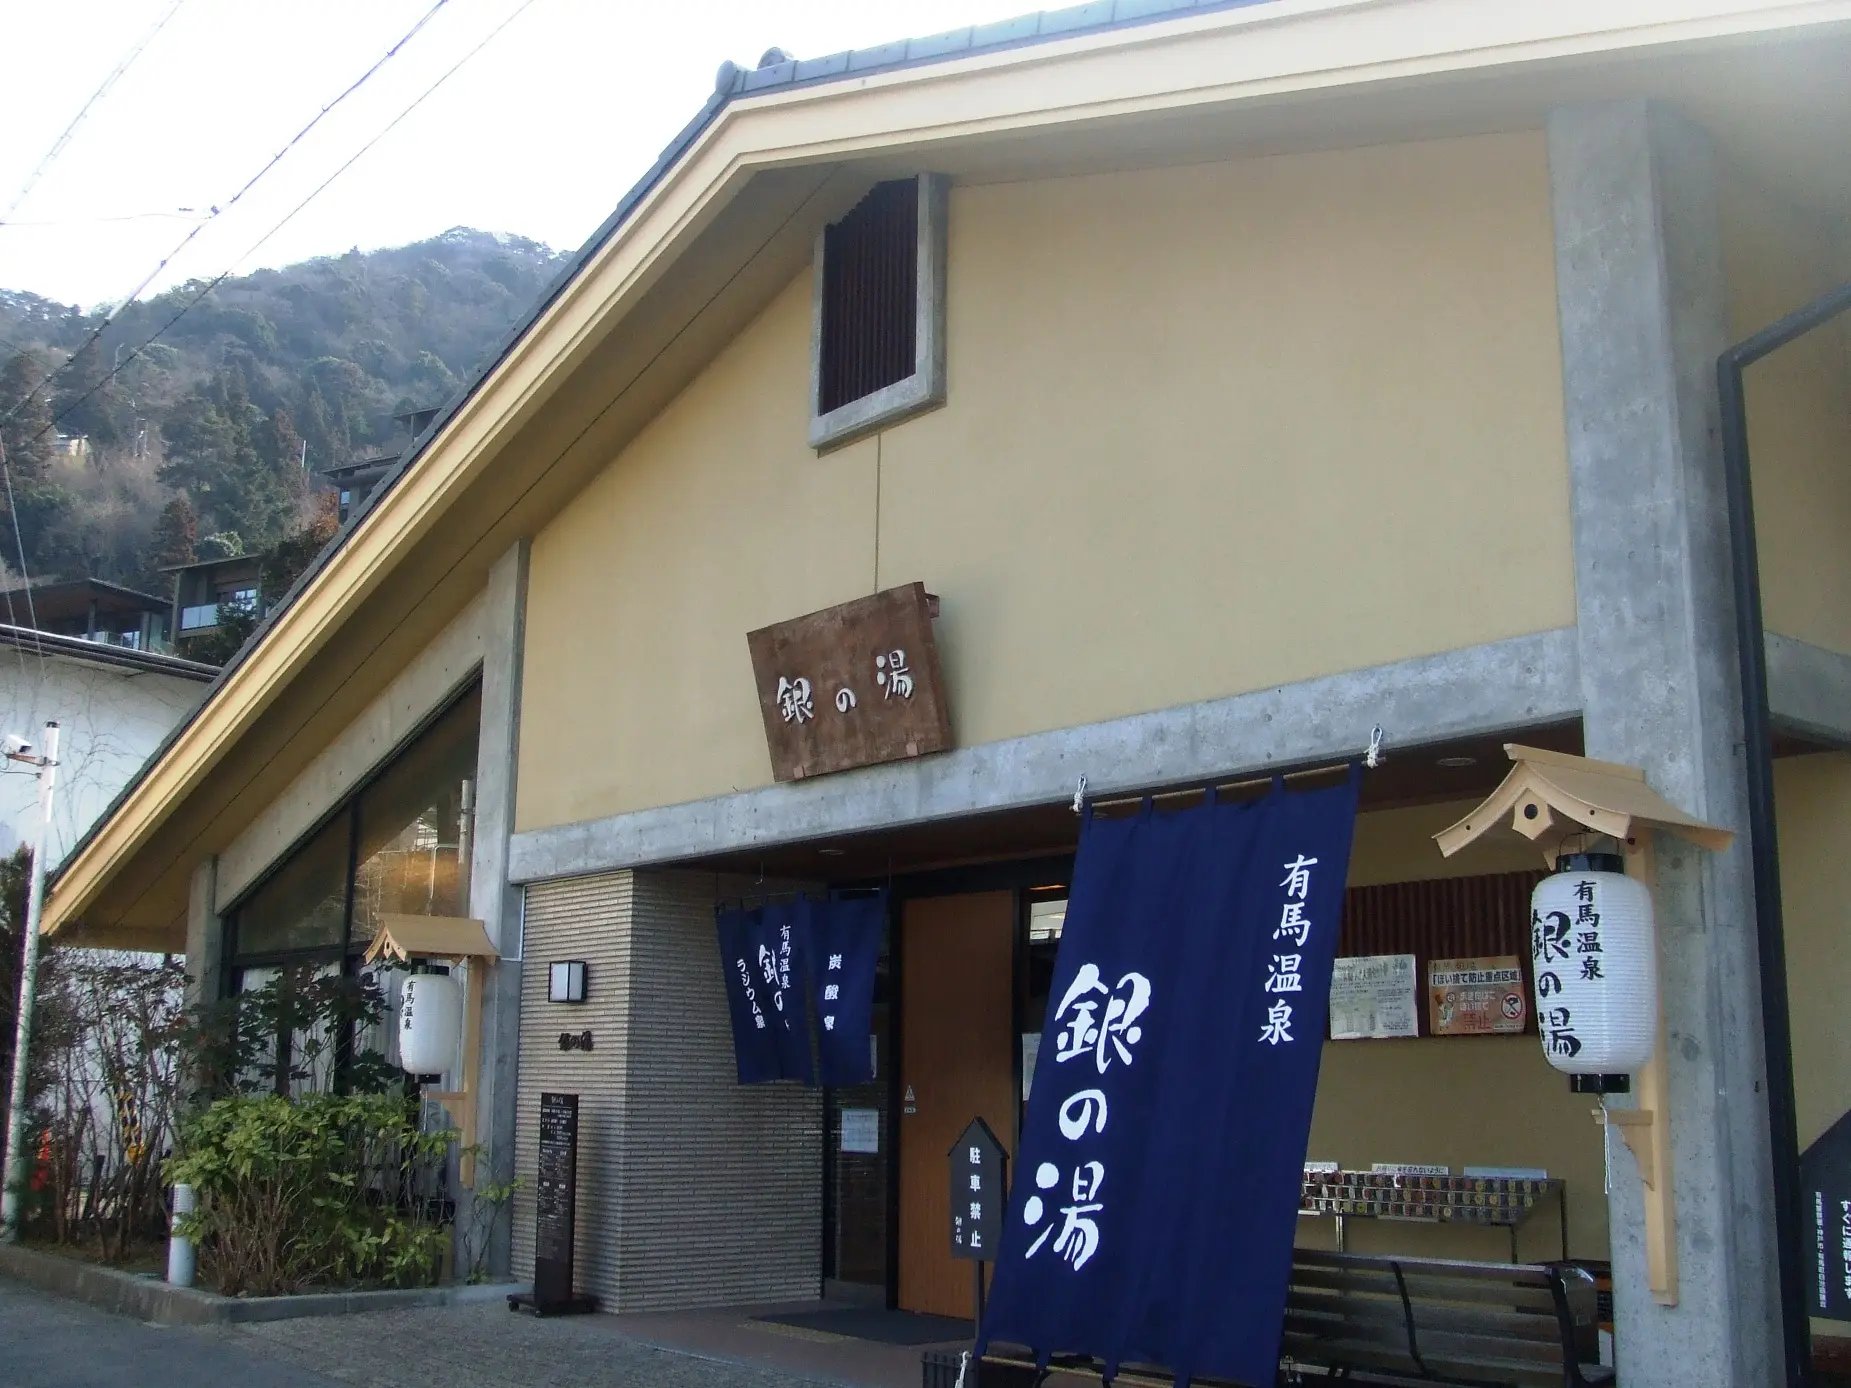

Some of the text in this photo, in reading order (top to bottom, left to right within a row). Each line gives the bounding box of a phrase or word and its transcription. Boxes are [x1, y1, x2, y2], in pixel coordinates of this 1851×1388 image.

[777, 649, 914, 724] 銀の湯
[780, 925, 792, 989] 有馬温泉
[1258, 854, 1318, 1046] 有馬温泉
[1573, 880, 1604, 980] 有馬温泉
[404, 980, 416, 1030] 有馬温泉
[737, 958, 766, 1029] ラジウム泉
[824, 954, 843, 1031] 炭酸泉
[1533, 908, 1583, 1058] 銀の湯
[1023, 962, 1152, 1272] 銀の湯
[969, 1147, 982, 1248] 駐車禁止
